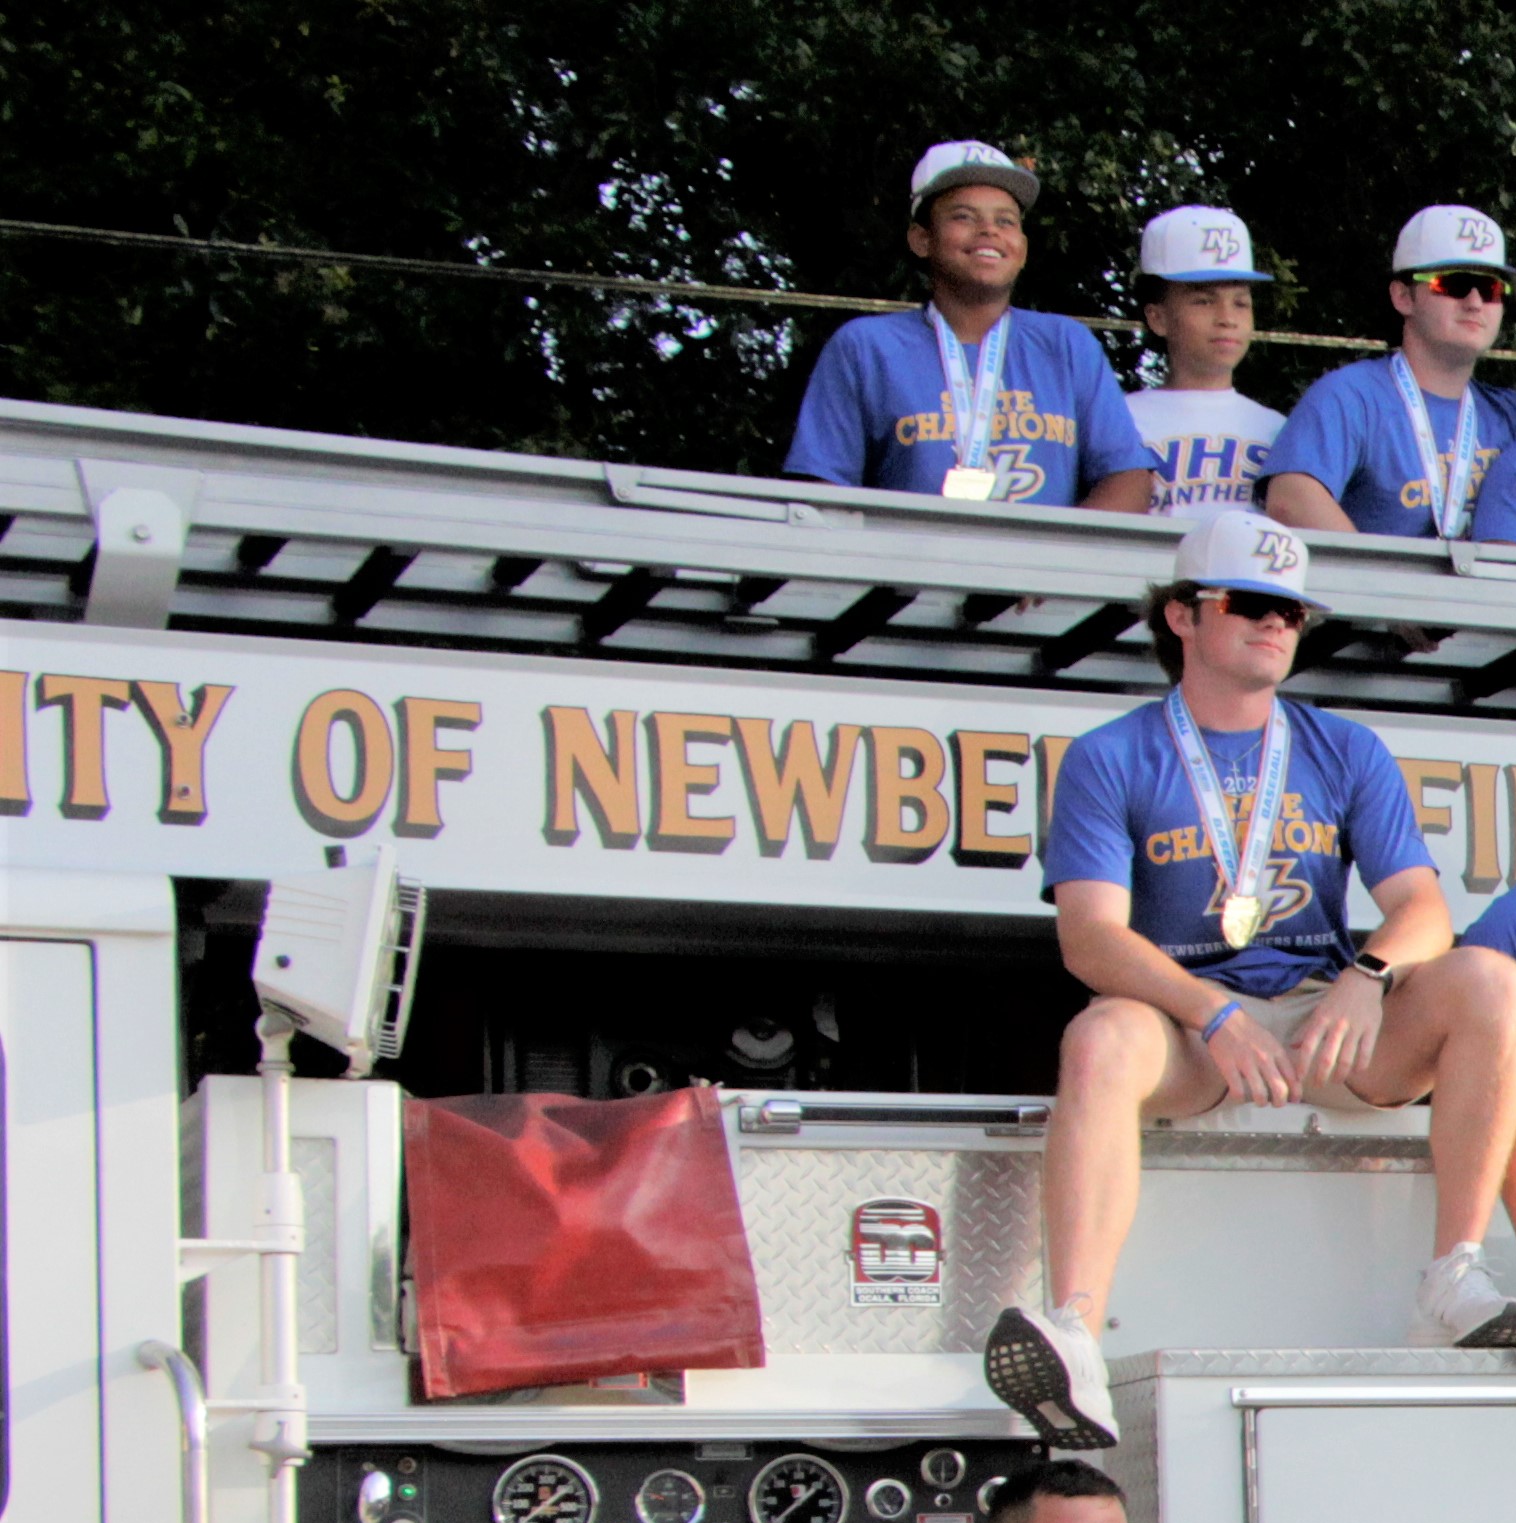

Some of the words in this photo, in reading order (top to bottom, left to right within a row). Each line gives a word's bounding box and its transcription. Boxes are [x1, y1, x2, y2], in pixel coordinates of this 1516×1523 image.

[940, 390, 1035, 414] STE
[895, 411, 1077, 448] CHAPIONS
[1150, 483, 1251, 512] ANTHE
[1251, 530, 1299, 575] NP
[291, 687, 483, 839] OF
[541, 704, 1076, 871] NEWBE
[1223, 776, 1257, 793] 202
[1260, 750, 1282, 820] BASEBALL
[907, 1286, 940, 1295] COACH
